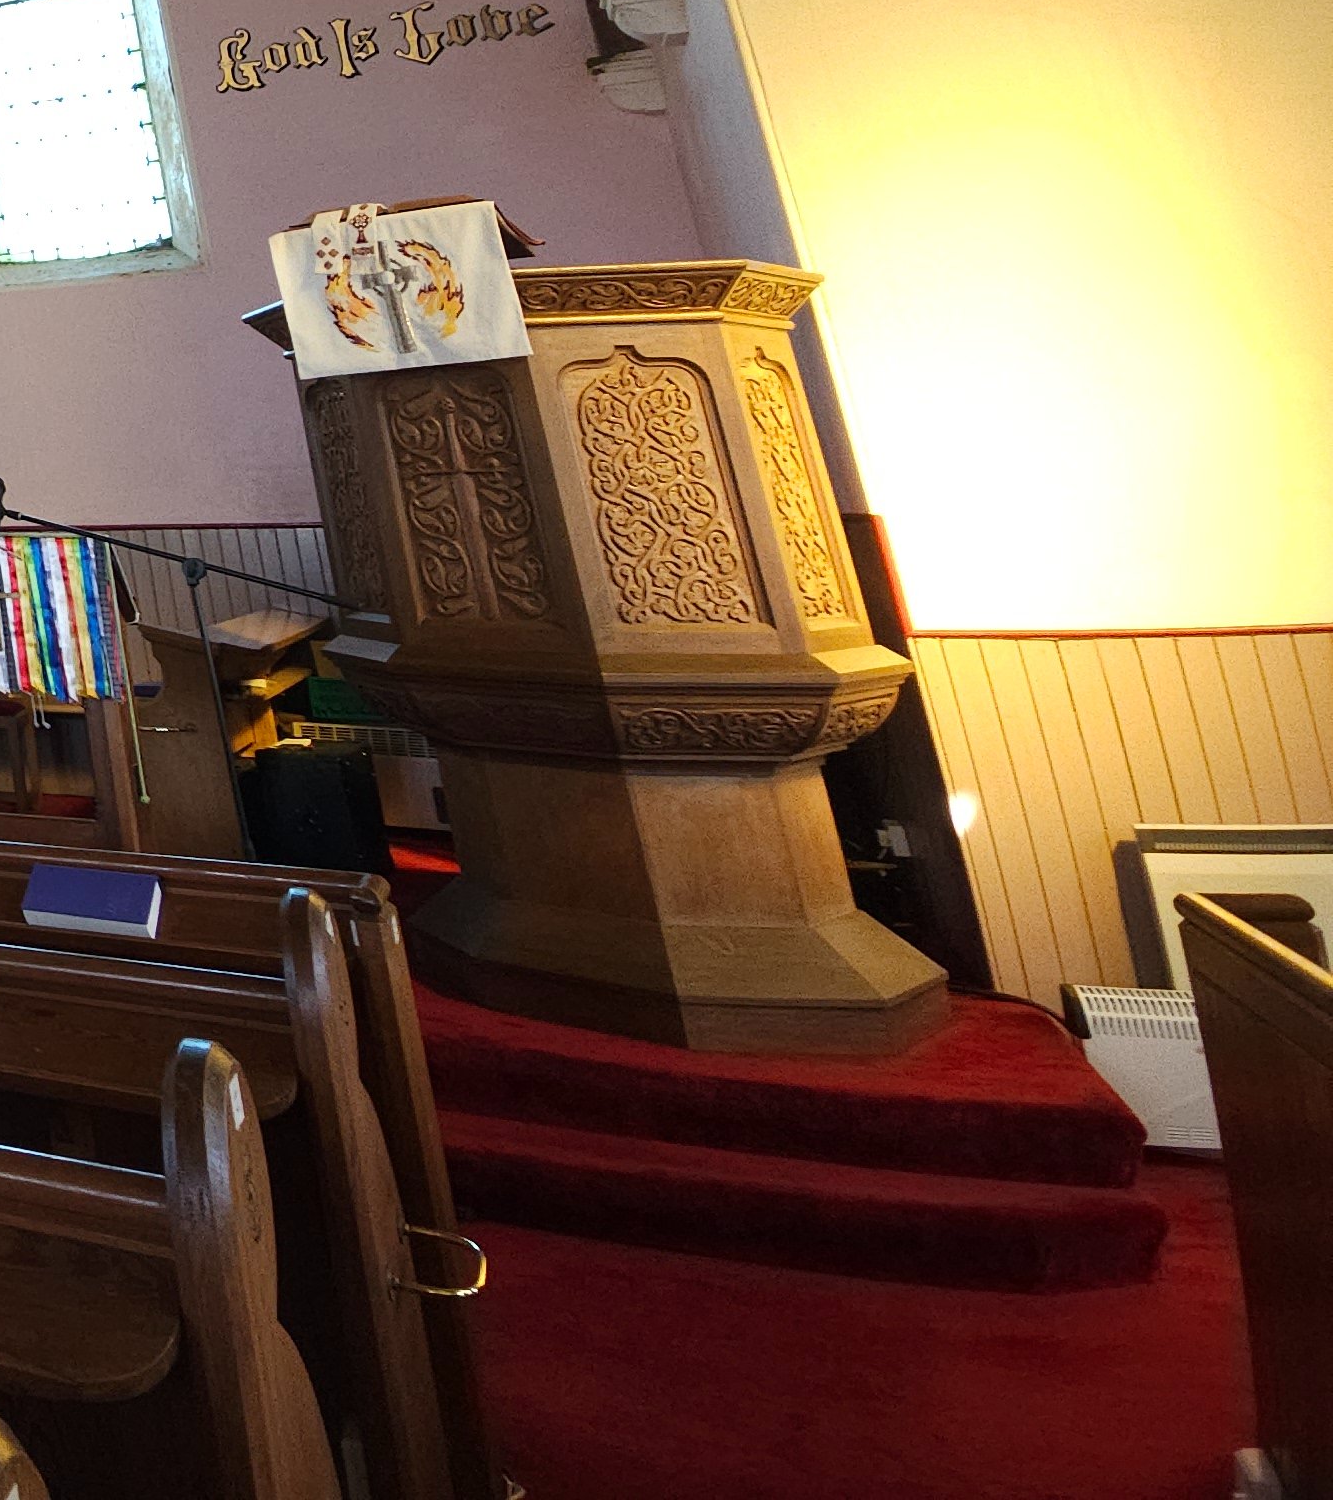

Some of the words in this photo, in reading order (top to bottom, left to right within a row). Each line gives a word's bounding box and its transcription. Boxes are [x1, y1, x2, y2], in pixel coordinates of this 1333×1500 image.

[216, 28, 328, 94] God
[329, 16, 380, 79] Is
[390, 0, 556, 66] Love
